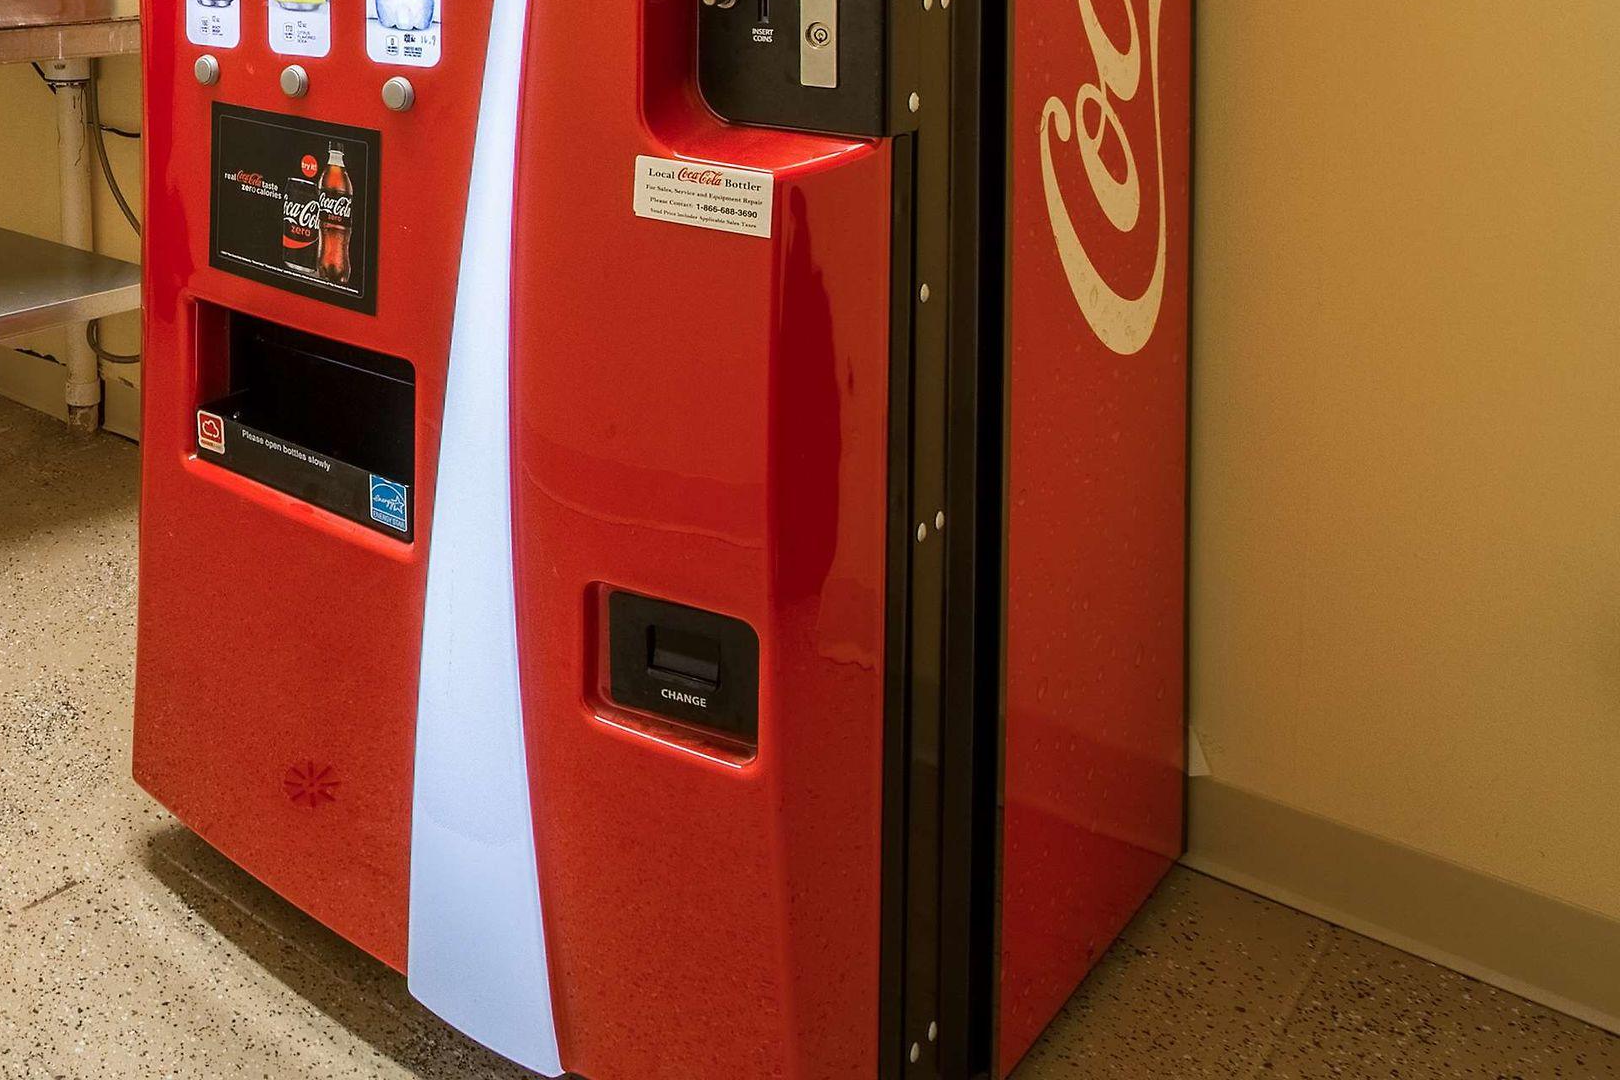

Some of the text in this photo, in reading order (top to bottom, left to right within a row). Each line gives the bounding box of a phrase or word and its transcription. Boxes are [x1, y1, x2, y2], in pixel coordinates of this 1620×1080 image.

[752, 35, 773, 43] COINS
[301, 161, 310, 171] try
[224, 172, 236, 181] real
[262, 181, 279, 191] taste
[648, 167, 762, 192] Local Coca-Cola Bottler
[241, 183, 282, 200] zero calories
[708, 193, 741, 203] Equipment
[742, 197, 763, 206] Repair
[291, 225, 311, 237] zero
[242, 429, 264, 446] Please
[265, 438, 282, 453] open
[282, 444, 307, 462] bottles
[307, 454, 331, 472] slowly
[661, 688, 708, 708] CHANGE
